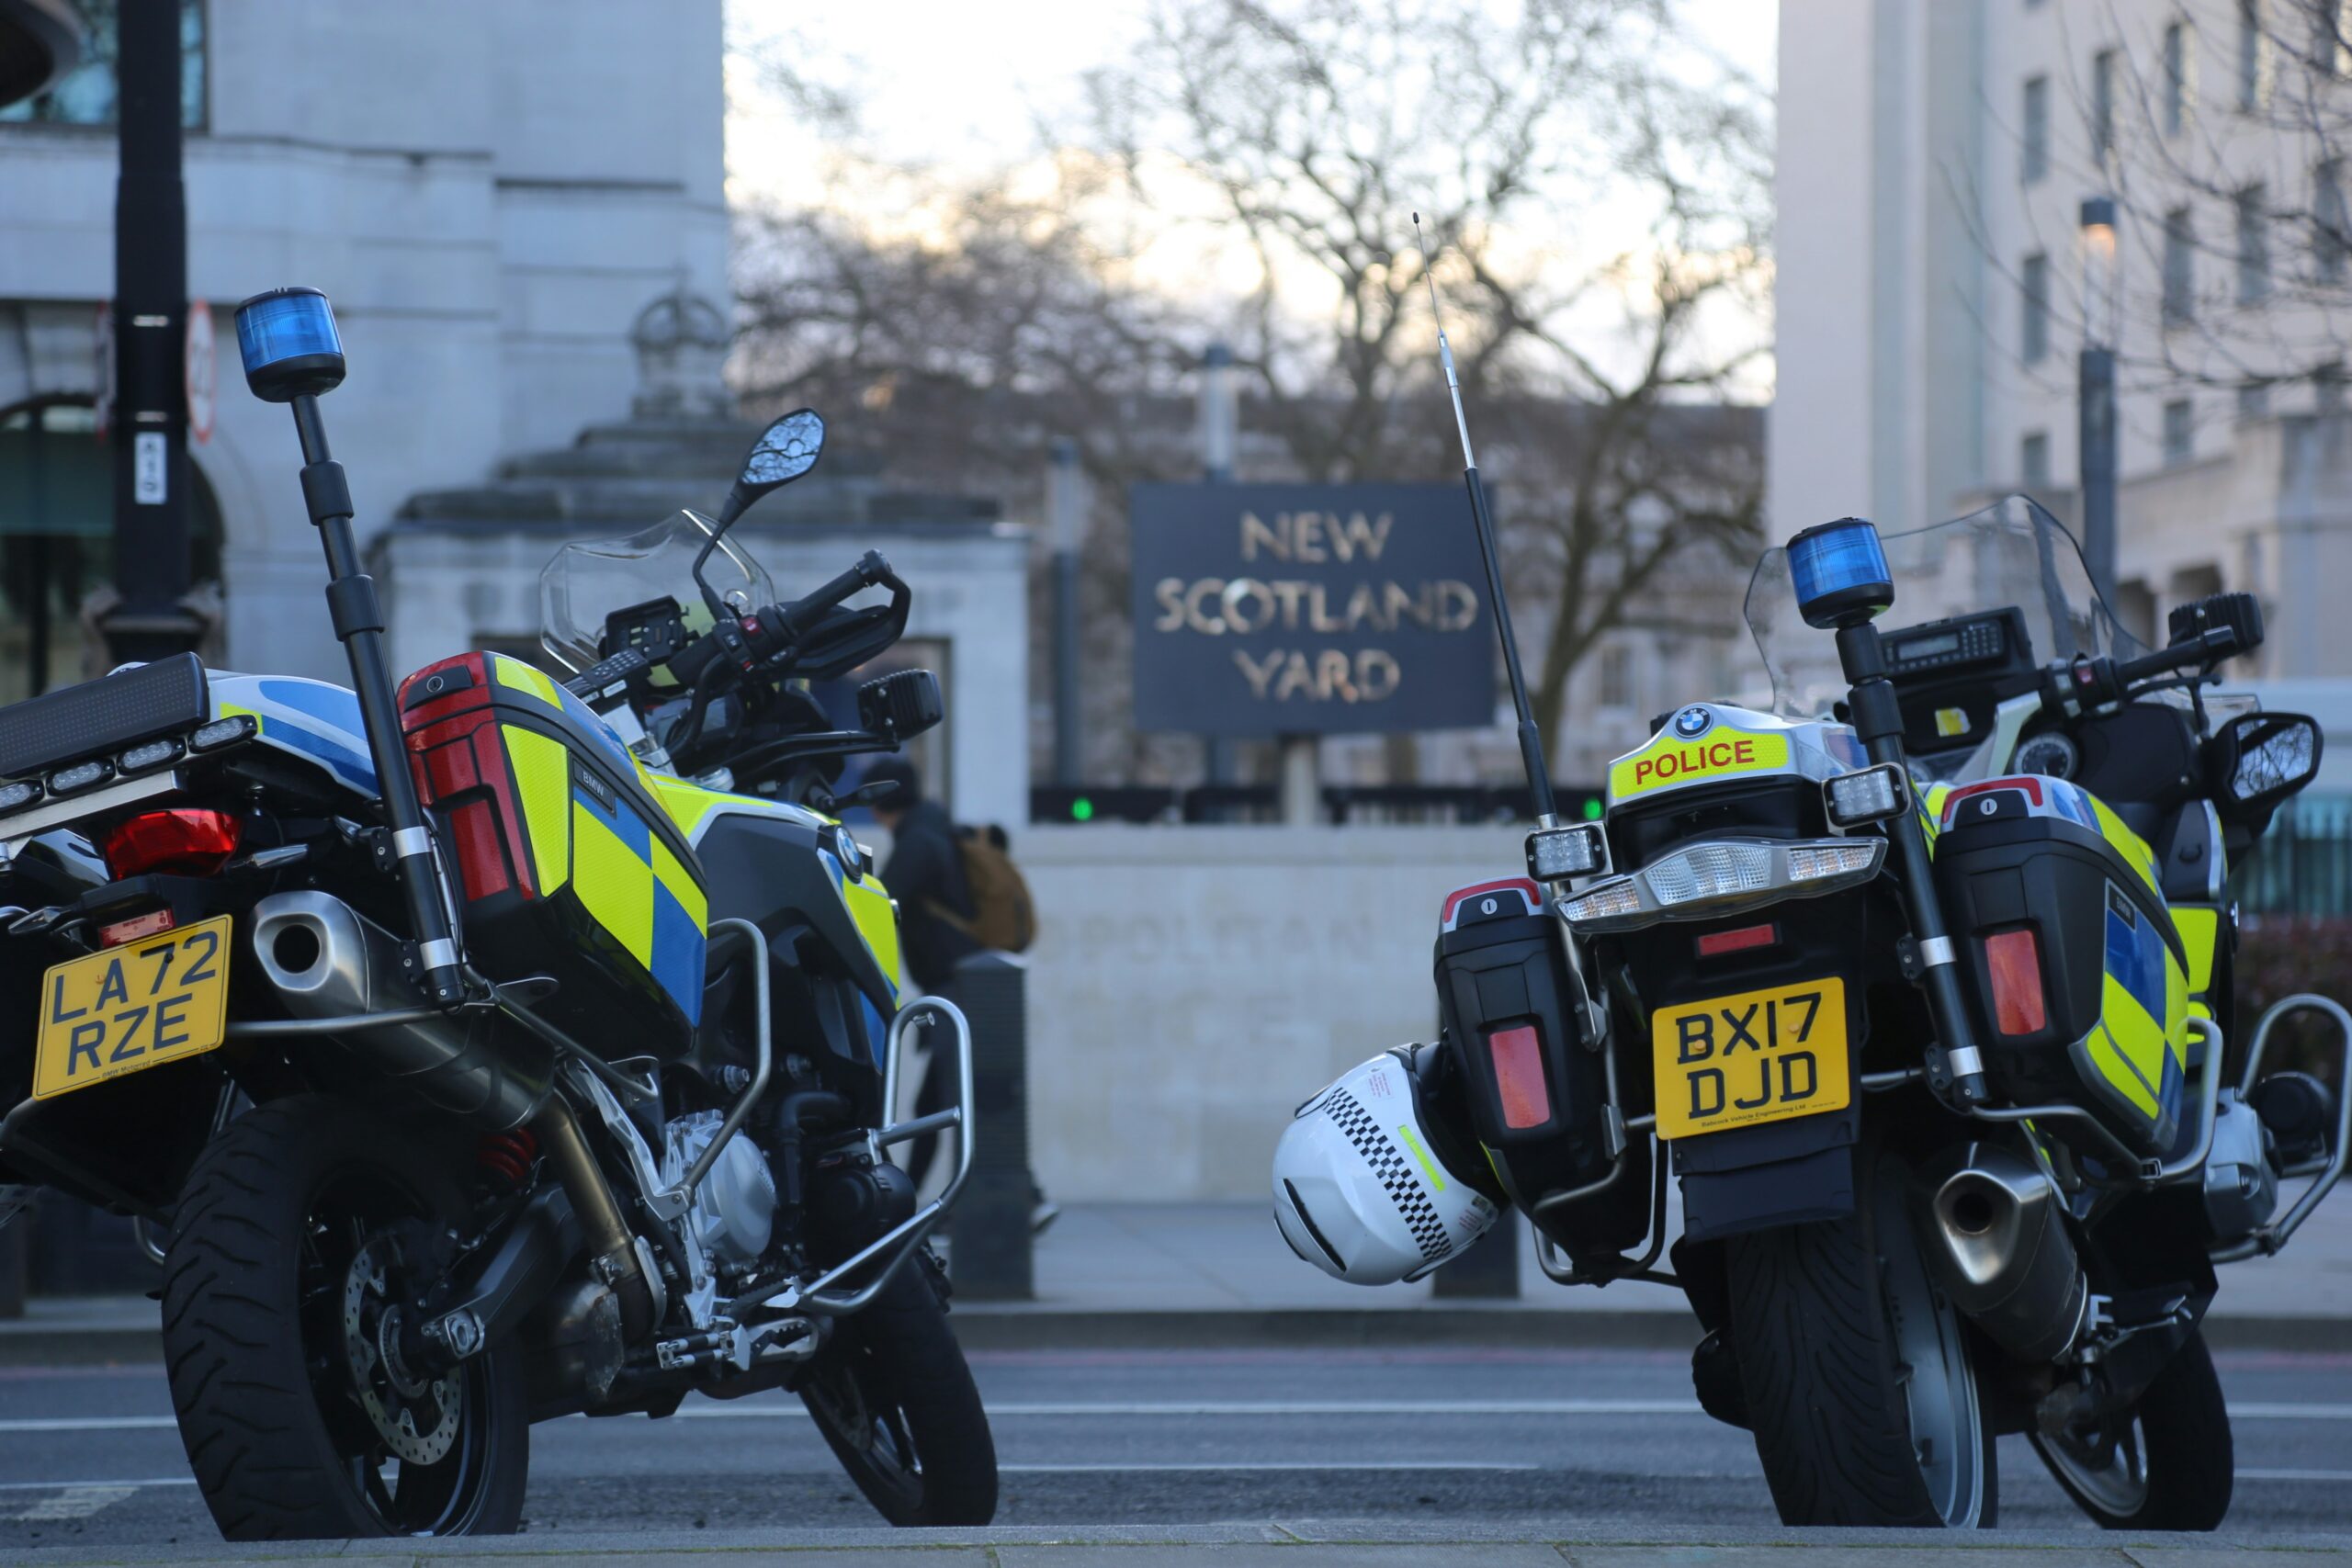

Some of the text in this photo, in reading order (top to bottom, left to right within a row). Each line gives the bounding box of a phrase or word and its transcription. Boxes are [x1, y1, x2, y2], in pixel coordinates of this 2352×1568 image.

[1240, 511, 1393, 562] NEW
[1155, 577, 1479, 634] SCOTLAND
[1232, 649, 1401, 704] YARD
[582, 771, 604, 796] BMW
[1635, 740, 1755, 785] POLICE
[52, 931, 219, 1024] LA72
[67, 993, 192, 1076] RZE
[1676, 992, 1821, 1065] BX17
[102, 1067, 119, 1077] BMW
[1687, 1051, 1817, 1120] DJD
[1702, 1117, 1728, 1127] Babcock
[1731, 1113, 1754, 1122] Vehicle
[1756, 1106, 1794, 1118] Engineering
